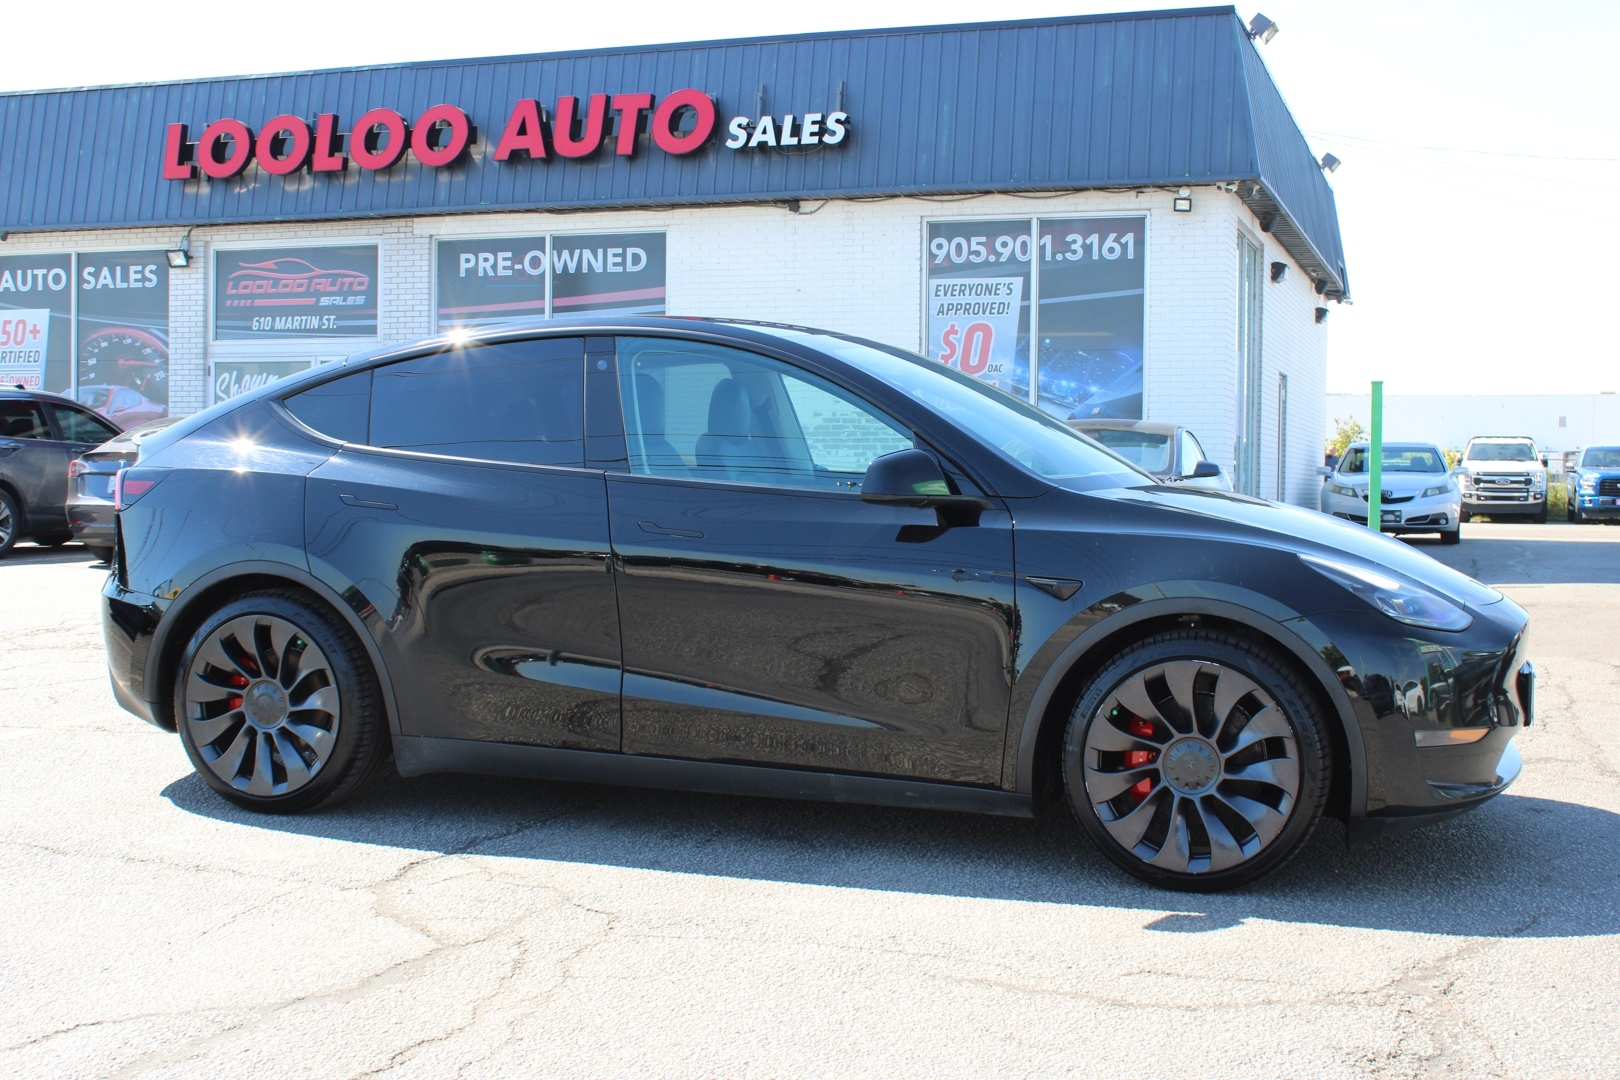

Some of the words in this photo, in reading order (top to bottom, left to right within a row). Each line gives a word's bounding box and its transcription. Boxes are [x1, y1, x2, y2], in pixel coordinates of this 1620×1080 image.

[163, 103, 470, 180] LOOLOO
[492, 87, 716, 162] AUTO
[725, 111, 849, 150] SALES
[930, 232, 1135, 264] 905.901.3161
[459, 247, 647, 277] PRE-OWNED
[0, 267, 67, 292] AUTO
[82, 264, 158, 290] SALES
[226, 279, 309, 294] LOOLOO
[310, 277, 370, 292] AUTO
[934, 282, 1014, 298] EVERYONE'S
[318, 295, 367, 306] SALES
[936, 301, 1011, 317] APPROVED!
[252, 316, 272, 331] 610
[274, 315, 320, 330] MARTIN
[321, 315, 337, 329] ST.
[940, 322, 993, 375] $0
[987, 363, 1004, 373] OAC
